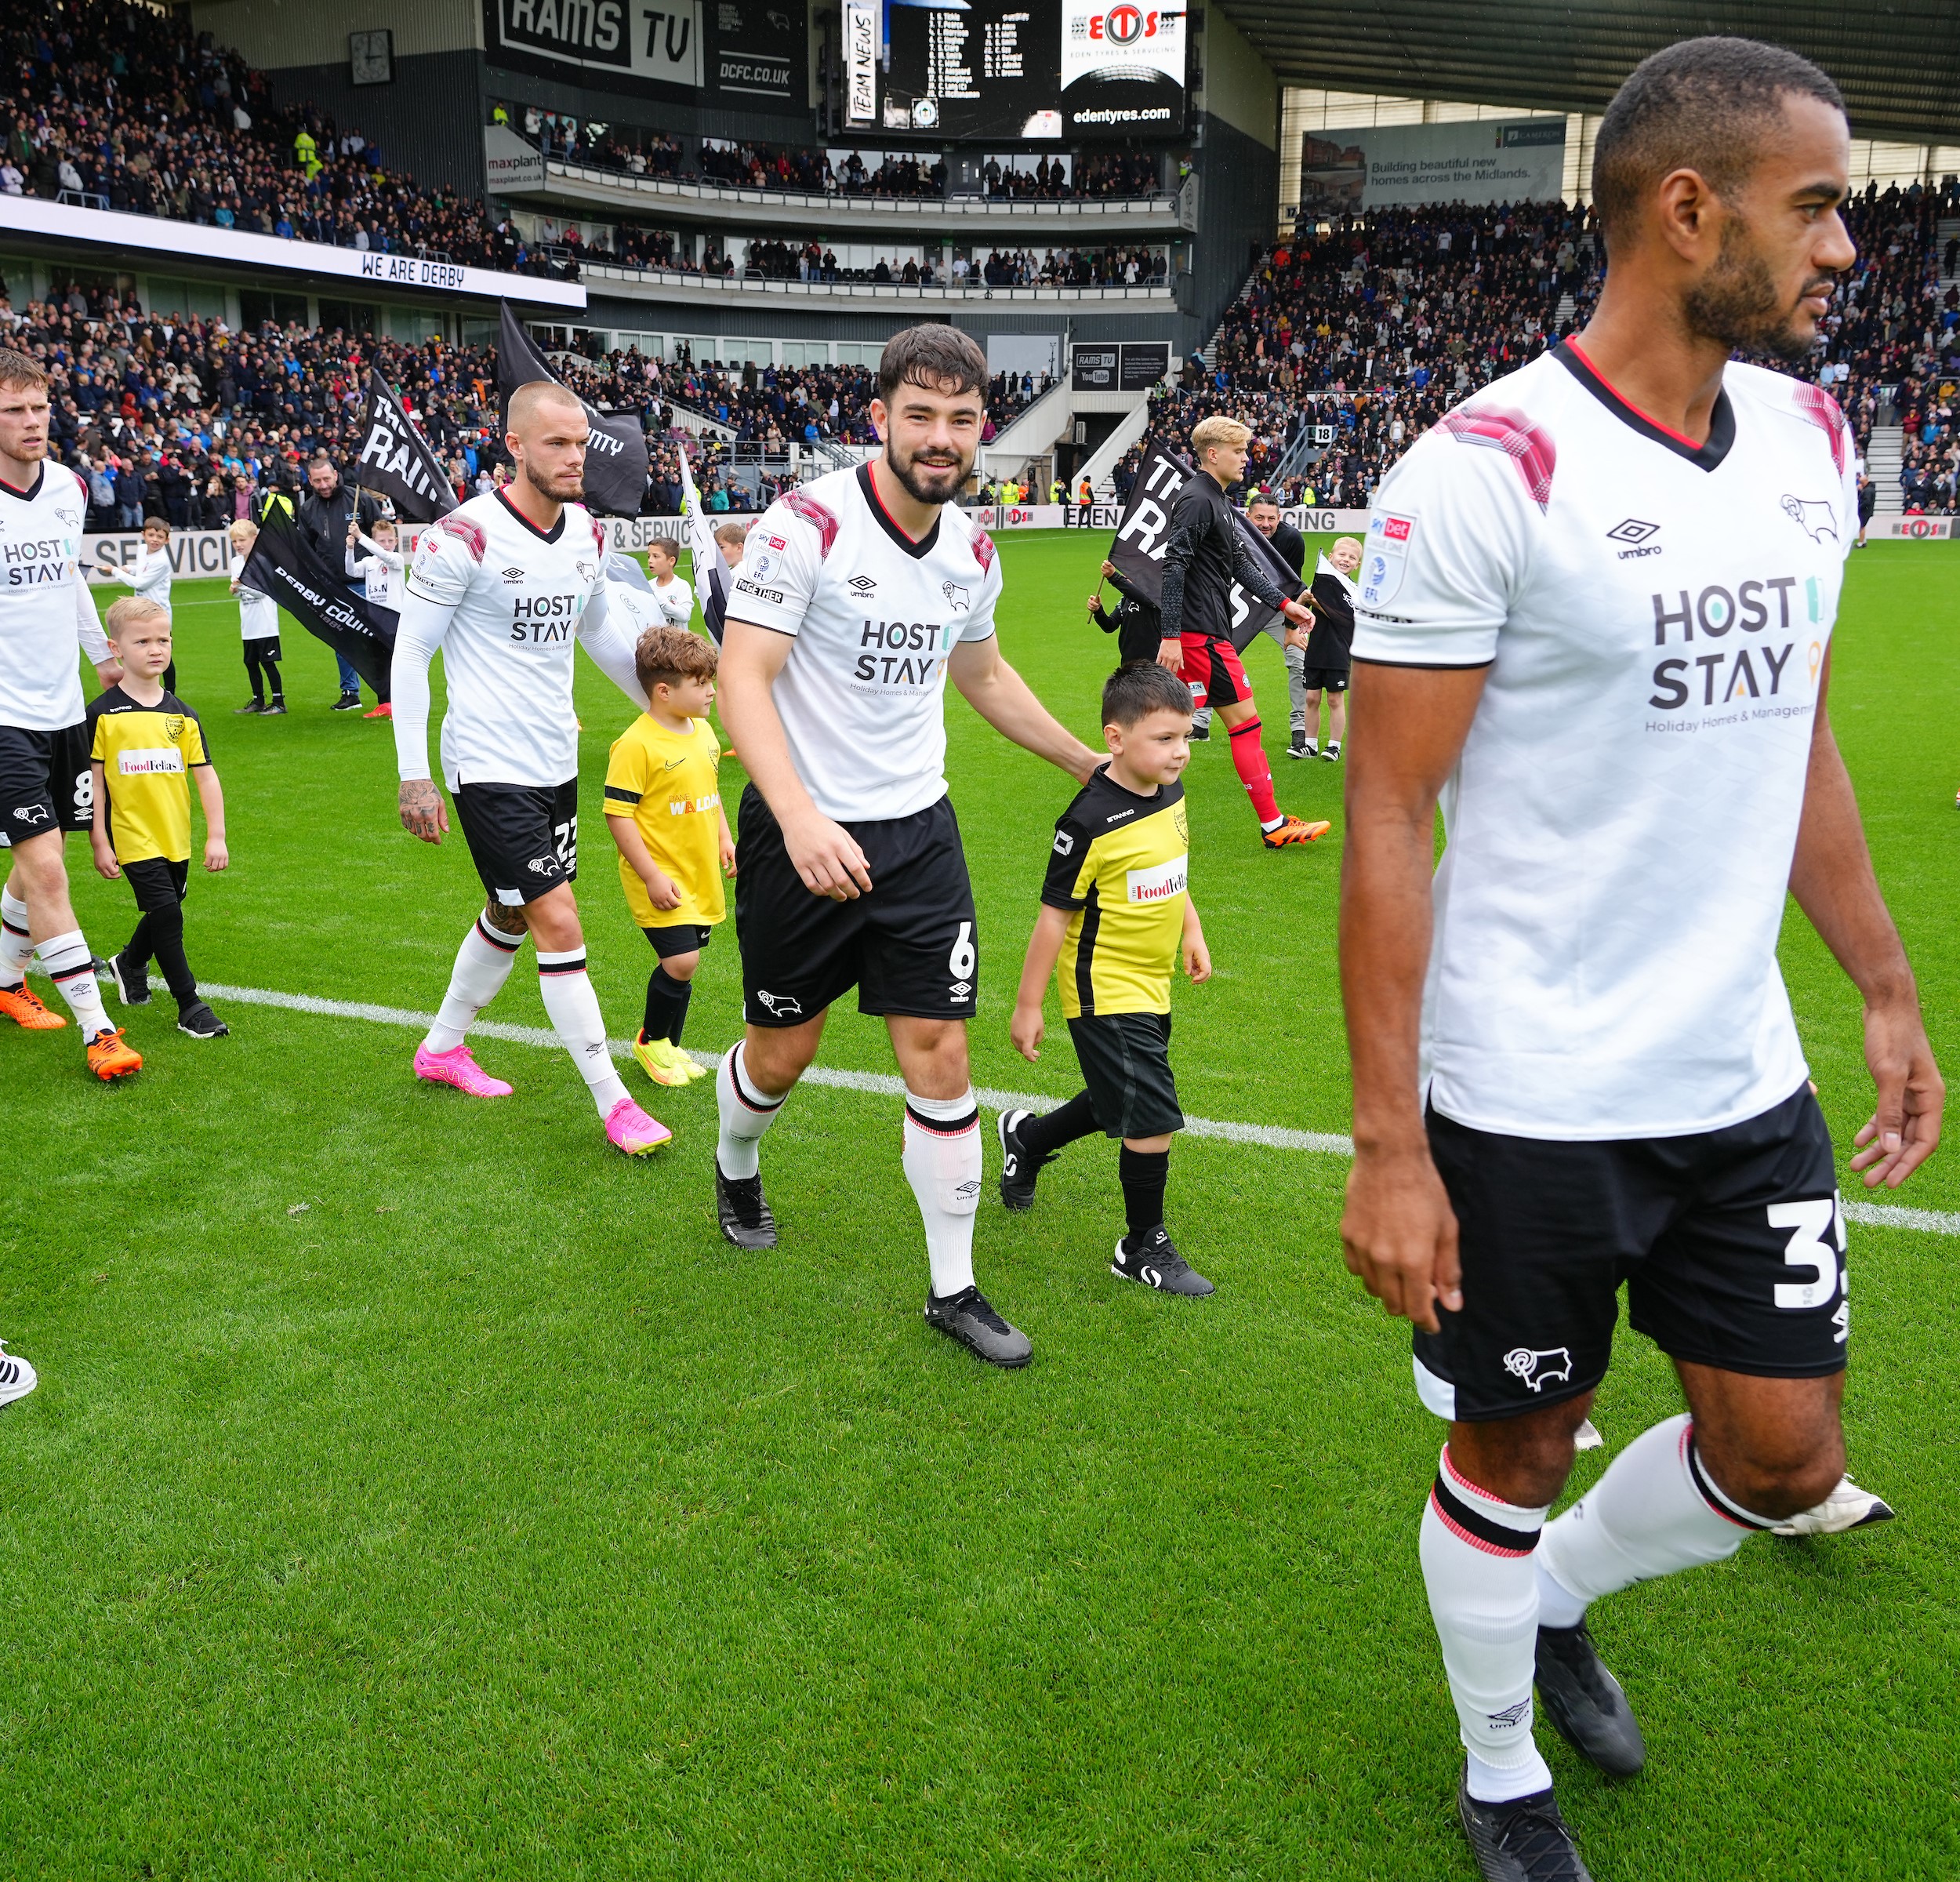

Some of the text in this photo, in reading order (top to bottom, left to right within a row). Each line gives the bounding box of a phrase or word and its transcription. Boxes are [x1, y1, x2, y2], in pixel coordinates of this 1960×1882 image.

[1089, 5, 1158, 42] ETS
[643, 9, 690, 63] TV
[1132, 46, 1176, 56] SERVICING
[854, 14, 872, 113] TEAM NEWS
[720, 63, 790, 84] DCFC.CO.UK
[1073, 107, 1171, 125] edentyres.com
[488, 154, 542, 170] maxplant
[1372, 158, 1497, 173] Building beautiful new
[489, 173, 543, 185] maxplant.co.uk
[1372, 168, 1531, 186] homes across the Midlands.
[1287, 208, 1297, 217] 17
[363, 254, 464, 288] WE ARE DERBY
[1079, 356, 1112, 365] RAMS TV
[1082, 372, 1109, 381] YouTube
[1318, 429, 1330, 439] 18
[1386, 521, 1409, 538] bet
[758, 533, 785, 549] sky bet
[4, 540, 60, 563] HOST
[1617, 545, 1662, 560] umbro
[9, 562, 64, 586] STAY
[753, 571, 764, 581] EFL
[274, 566, 327, 606] DERBY
[737, 579, 782, 604] TOGETHER
[1365, 587, 1378, 602] EFL
[514, 594, 575, 618] HOST
[1652, 576, 1796, 646] HOST
[510, 620, 572, 643] STAY
[861, 620, 941, 652] HOST
[854, 655, 935, 685] STAY
[1648, 643, 1795, 710] STAY
[850, 683, 879, 696] Holiday
[1645, 717, 1699, 733] Holiday
[1702, 714, 1737, 729] Homes
[1740, 711, 1749, 721] &
[125, 760, 177, 772] FoodFellas
[73, 769, 93, 807] 8
[669, 793, 690, 802] DANE
[1106, 808, 1135, 823] STANNO
[949, 921, 975, 979] 6
